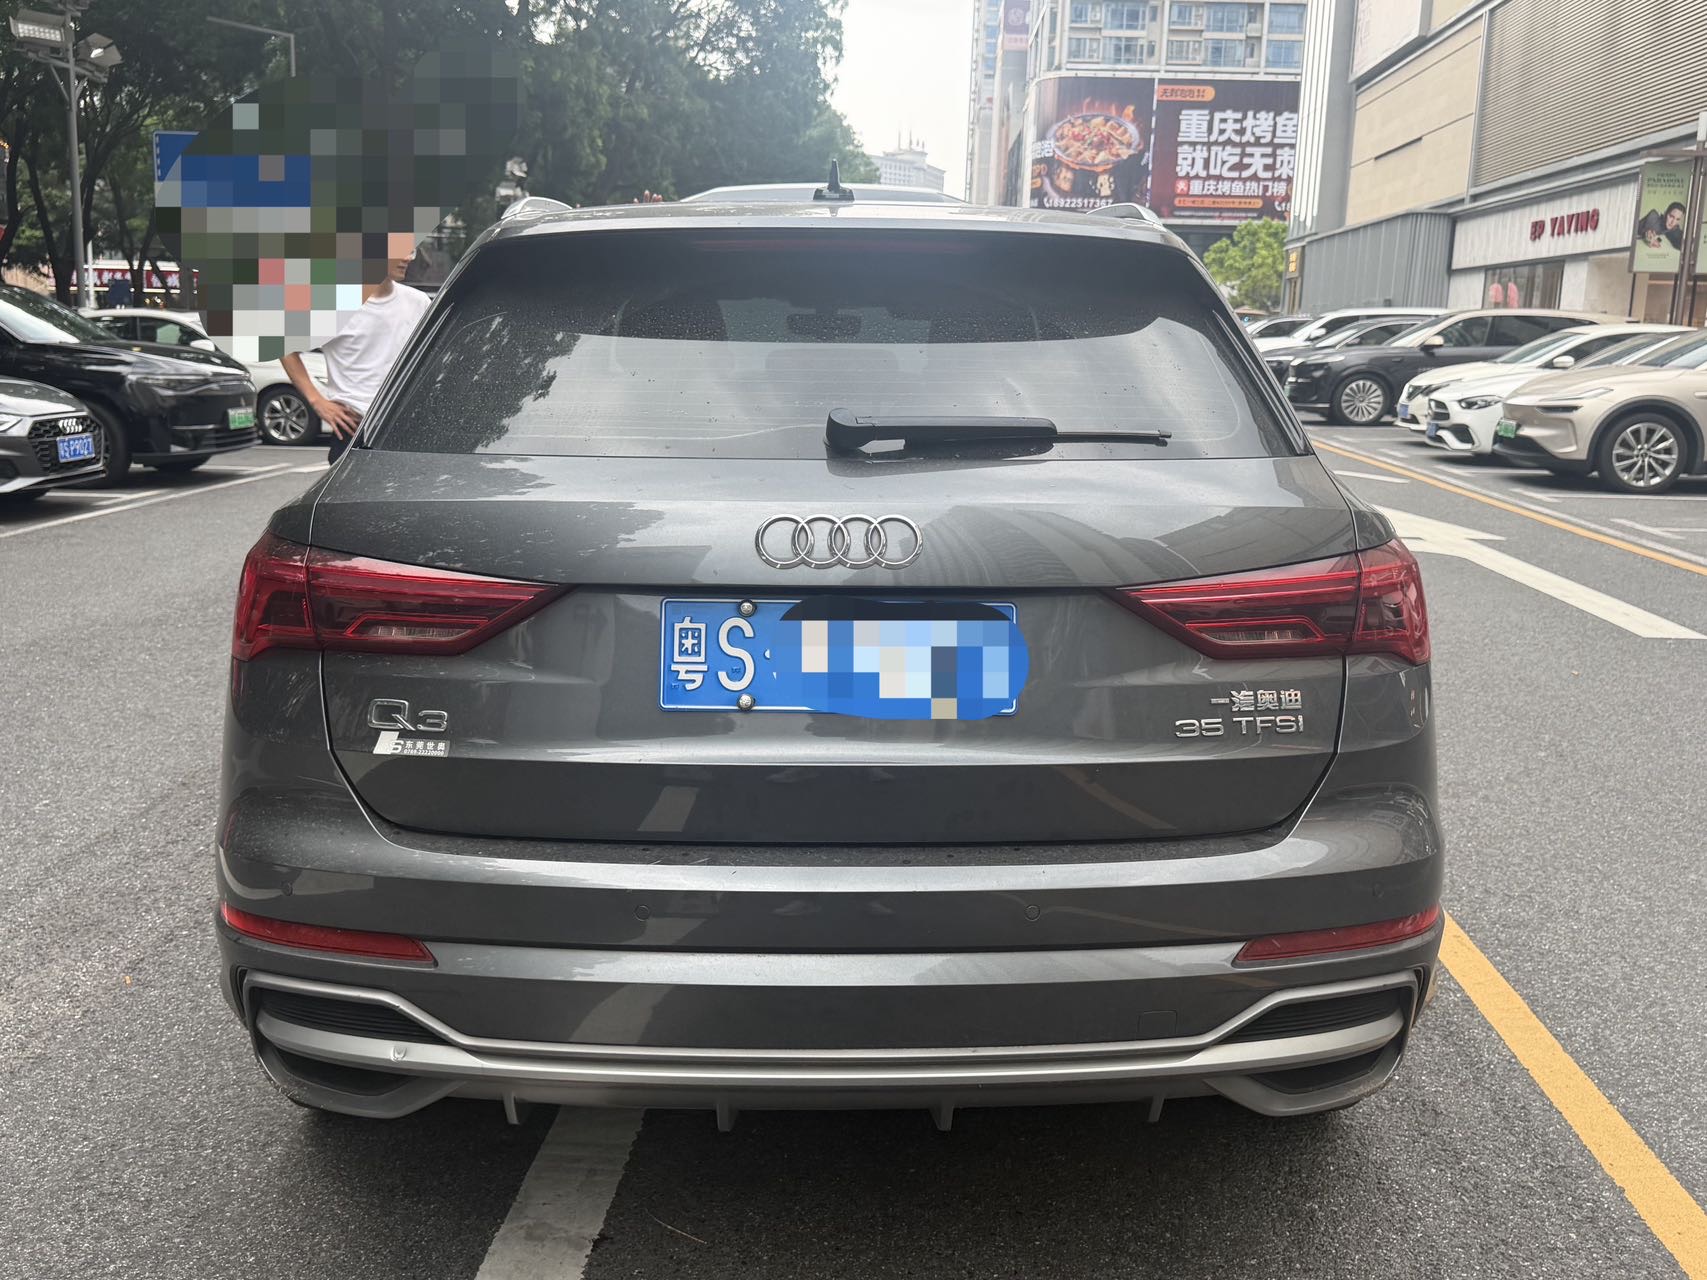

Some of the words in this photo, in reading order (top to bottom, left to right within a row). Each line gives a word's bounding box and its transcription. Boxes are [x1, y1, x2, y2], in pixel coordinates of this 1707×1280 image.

[1177, 109, 1298, 144] 重庆烤鱼
[1189, 180, 1287, 196] 重庆烤鱼热门榜
[1550, 208, 1599, 237] YAYING
[1210, 689, 1302, 712] 一汽奥迪
[368, 698, 448, 731] Q3
[1175, 718, 1224, 737] 35
[1232, 714, 1304, 734] TFSI
